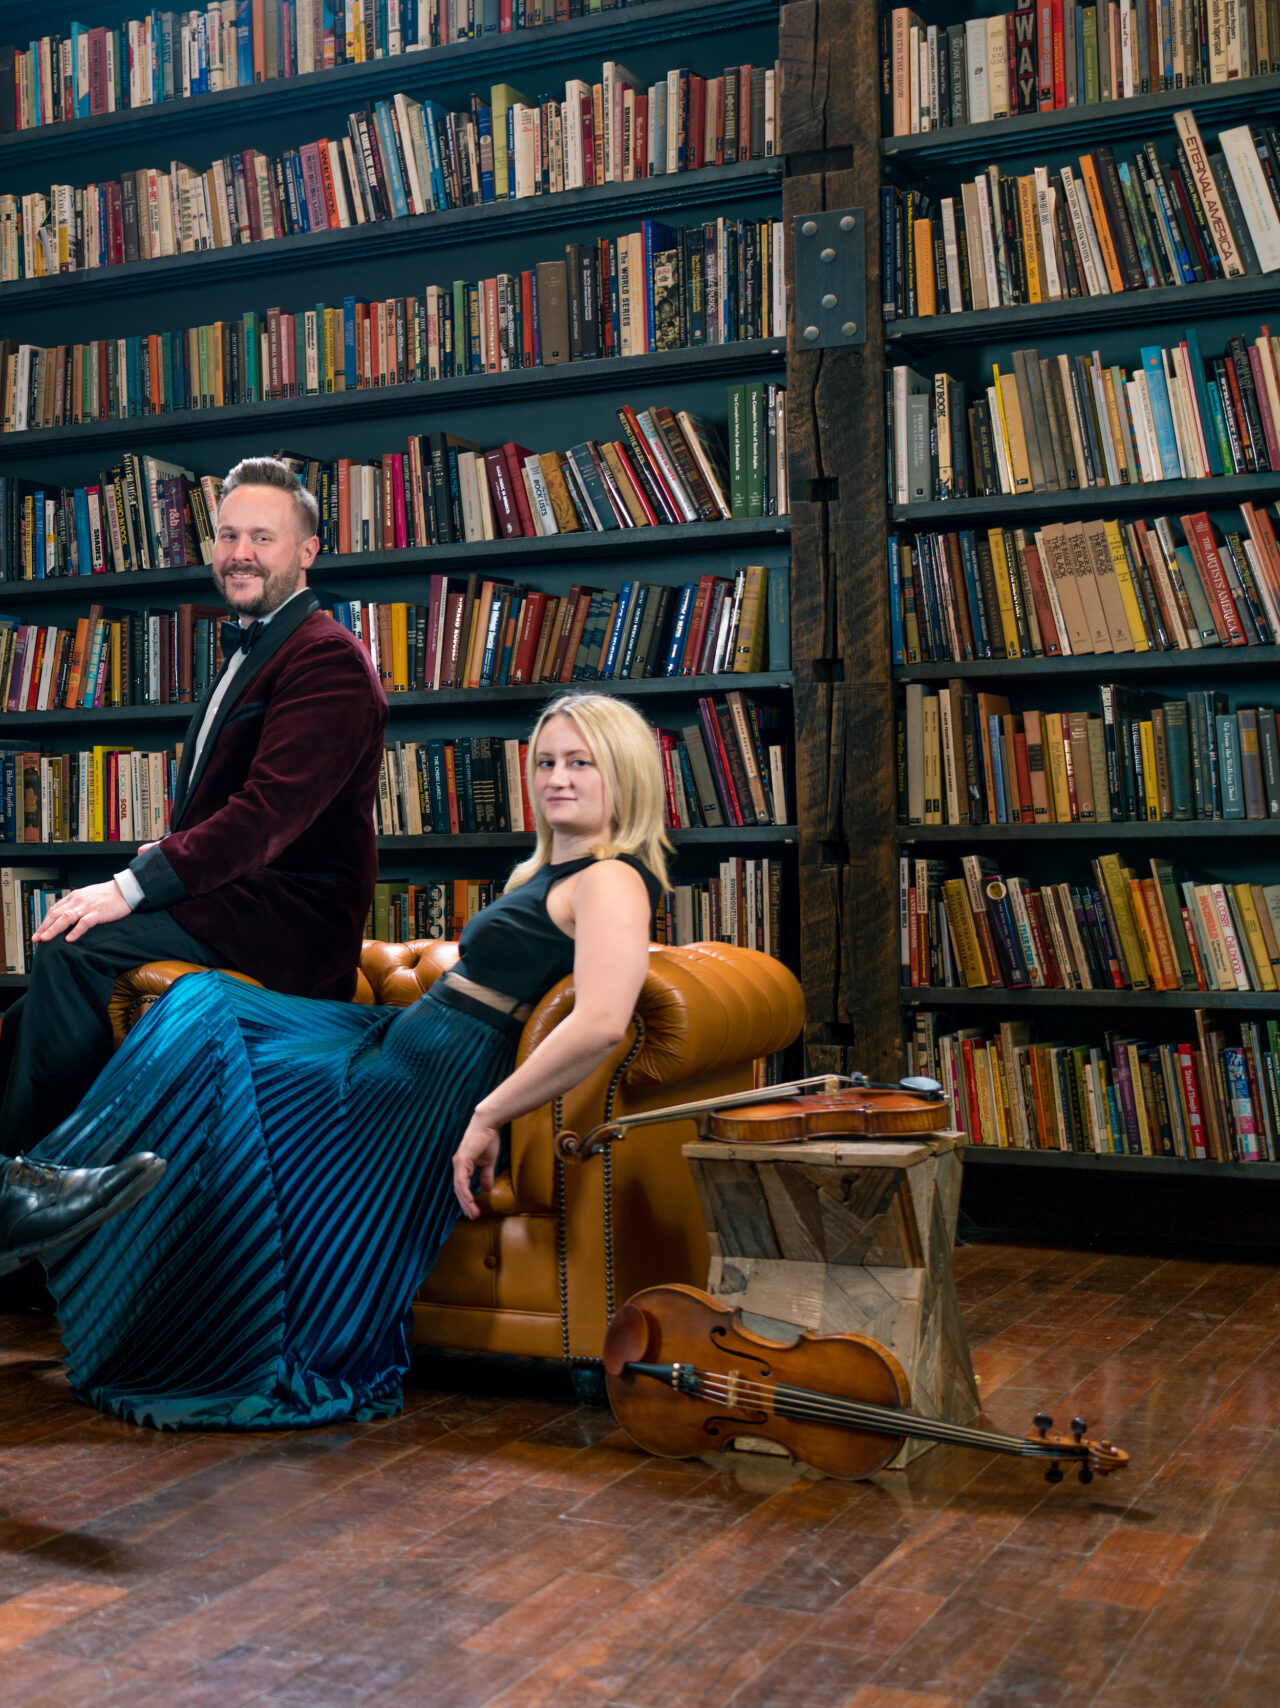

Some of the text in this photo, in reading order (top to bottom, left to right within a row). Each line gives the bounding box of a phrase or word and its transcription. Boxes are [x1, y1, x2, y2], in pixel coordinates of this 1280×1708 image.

[896, 17, 903, 28] ON
[163, 32, 171, 63] CASEY
[897, 74, 905, 98] SHOW
[952, 38, 963, 118] SLOW FADE TO BLACK
[358, 121, 369, 133] THE
[360, 134, 370, 151] GAME
[363, 157, 374, 168] THE
[366, 169, 377, 187] GLORY
[320, 148, 336, 217] SANDLOT SEASONS
[1186, 137, 1233, 261] ETERNAL AMERICA
[58, 188, 67, 217] Wink
[182, 189, 191, 241] AMAZING
[260, 176, 273, 229] AMAZING
[621, 250, 629, 265] The
[622, 297, 630, 327] SERIES
[936, 376, 946, 418] TV BOOK
[1220, 378, 1241, 460] STRAIGHT LICK
[533, 479, 547, 517] ROCK LISTS
[169, 508, 179, 526] r&b
[94, 529, 102, 561] SHADES
[1052, 538, 1066, 578] THE BLACK
[1071, 537, 1086, 577] THE BLACK
[1092, 535, 1106, 576] THE BLACK
[1203, 537, 1214, 551] THE
[1215, 587, 1238, 633] AMERICA
[451, 597, 463, 662] RICHARD RODGERS
[97, 642, 107, 683] VOICE OVER
[1224, 722, 1231, 731] Up
[1224, 732, 1232, 746] from
[1225, 758, 1235, 784] Walking
[4, 786, 14, 817] Rhythms
[1228, 786, 1236, 801] Dead
[1199, 894, 1219, 940] BUCHWALD
[1213, 890, 1242, 975] BILL COSBY CHILDHOOD
[1019, 924, 1035, 966] TYLER PERRY
